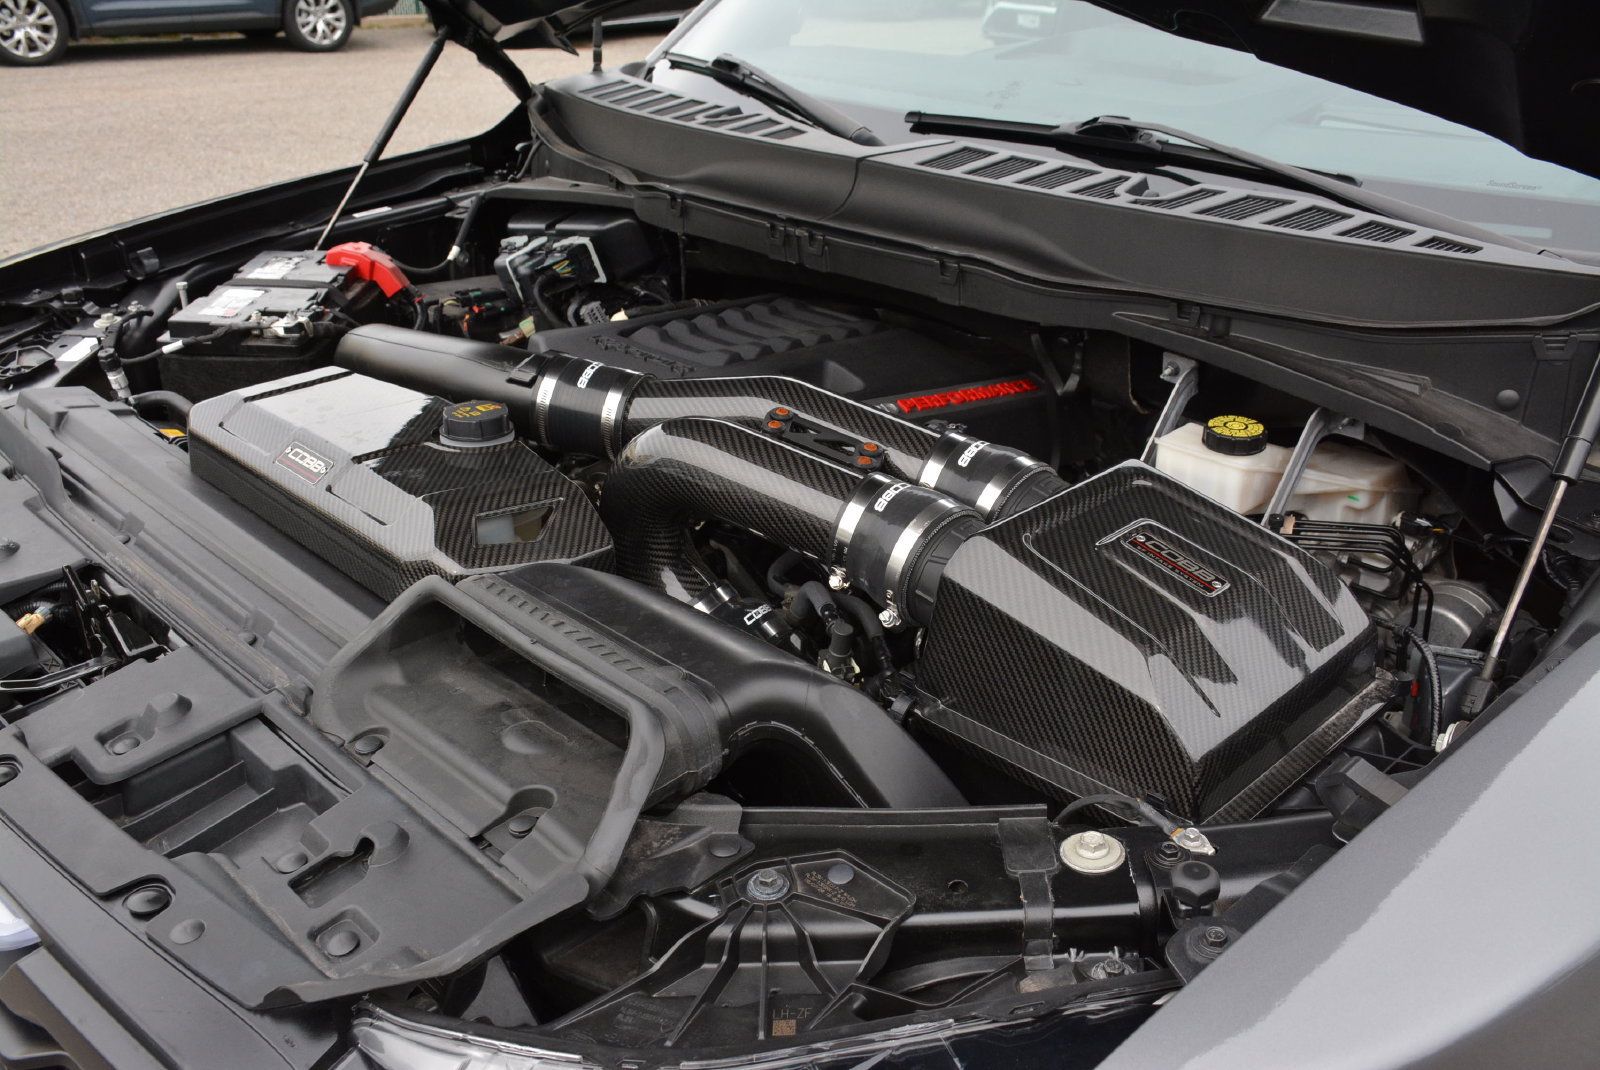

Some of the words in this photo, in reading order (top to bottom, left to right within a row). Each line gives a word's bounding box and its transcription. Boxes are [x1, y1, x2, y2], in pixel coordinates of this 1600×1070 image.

[288, 448, 325, 473] COBB
[874, 482, 911, 512] COBB
[1145, 540, 1216, 582] COBB
